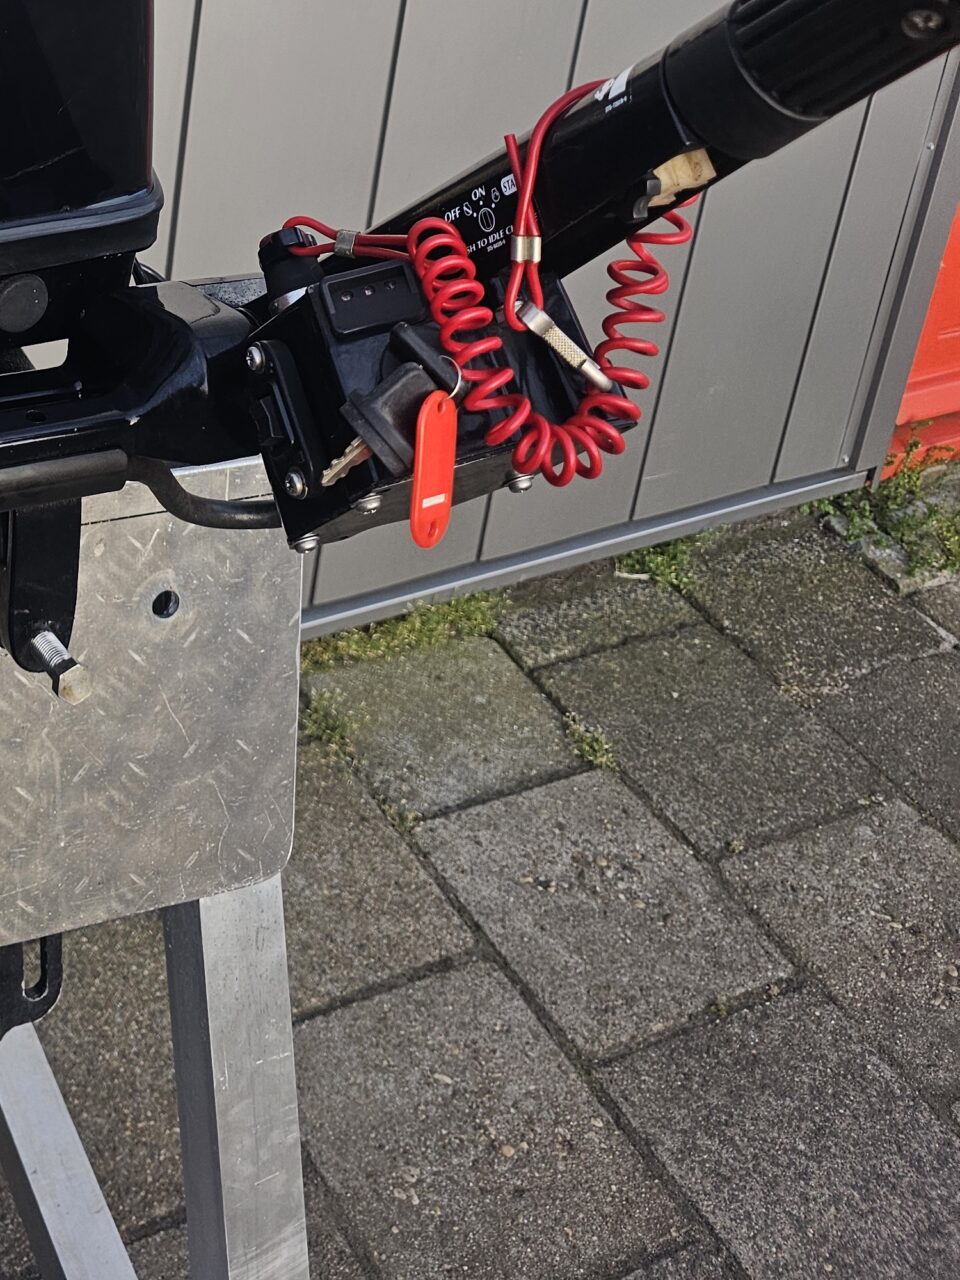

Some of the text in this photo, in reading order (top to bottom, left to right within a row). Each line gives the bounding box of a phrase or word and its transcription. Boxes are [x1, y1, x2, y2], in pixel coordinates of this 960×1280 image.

[471, 185, 485, 200] ON
[444, 207, 461, 223] OFF
[477, 238, 488, 249] TO
[489, 231, 505, 243] IDLE
